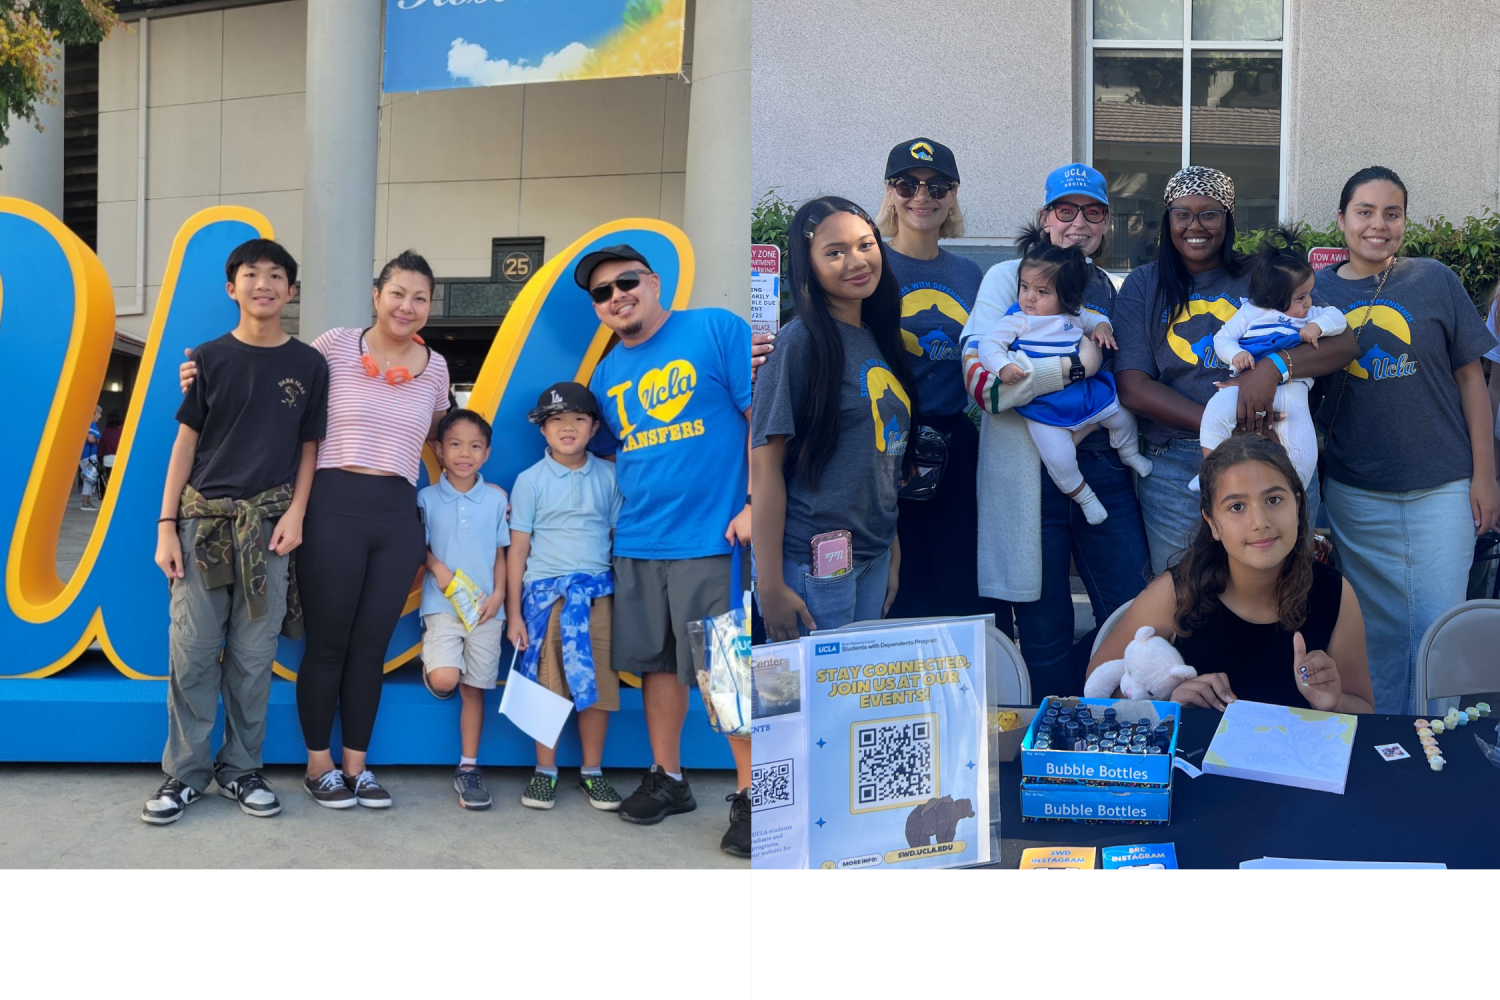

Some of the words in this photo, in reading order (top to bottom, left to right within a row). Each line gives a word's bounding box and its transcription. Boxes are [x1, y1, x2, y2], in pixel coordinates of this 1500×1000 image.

[758, 250, 776, 258] ZONE
[1313, 253, 1329, 261] TOW
[506, 258, 529, 275] 25
[911, 281, 931, 291] WITH
[933, 282, 972, 315] DEPENDENT
[1348, 300, 1368, 310] WITH
[1372, 353, 1417, 380] Ucla
[607, 380, 636, 439] I
[642, 367, 692, 410] Ucla
[825, 549, 844, 562] Ucla
[818, 644, 837, 653] UCLA
[880, 640, 914, 648] Dependents
[914, 638, 939, 646] Program
[816, 665, 862, 683] STAY
[863, 656, 971, 677] CONNECTED,
[828, 679, 871, 697] JOIN
[872, 676, 897, 691] US
[899, 674, 922, 689] AT
[921, 670, 960, 686] OUR
[860, 688, 931, 708] EVENTS!
[1046, 762, 1095, 776] Bubble
[1099, 765, 1148, 780] Bottles
[1044, 803, 1093, 816] Bubble
[1098, 805, 1147, 817] Bottles
[769, 826, 792, 834] students
[761, 848, 782, 856] website
[897, 844, 954, 859] SWD.UCLA.EDU
[1111, 853, 1165, 862] INSTAGRAM
[842, 859, 862, 867] MORE
